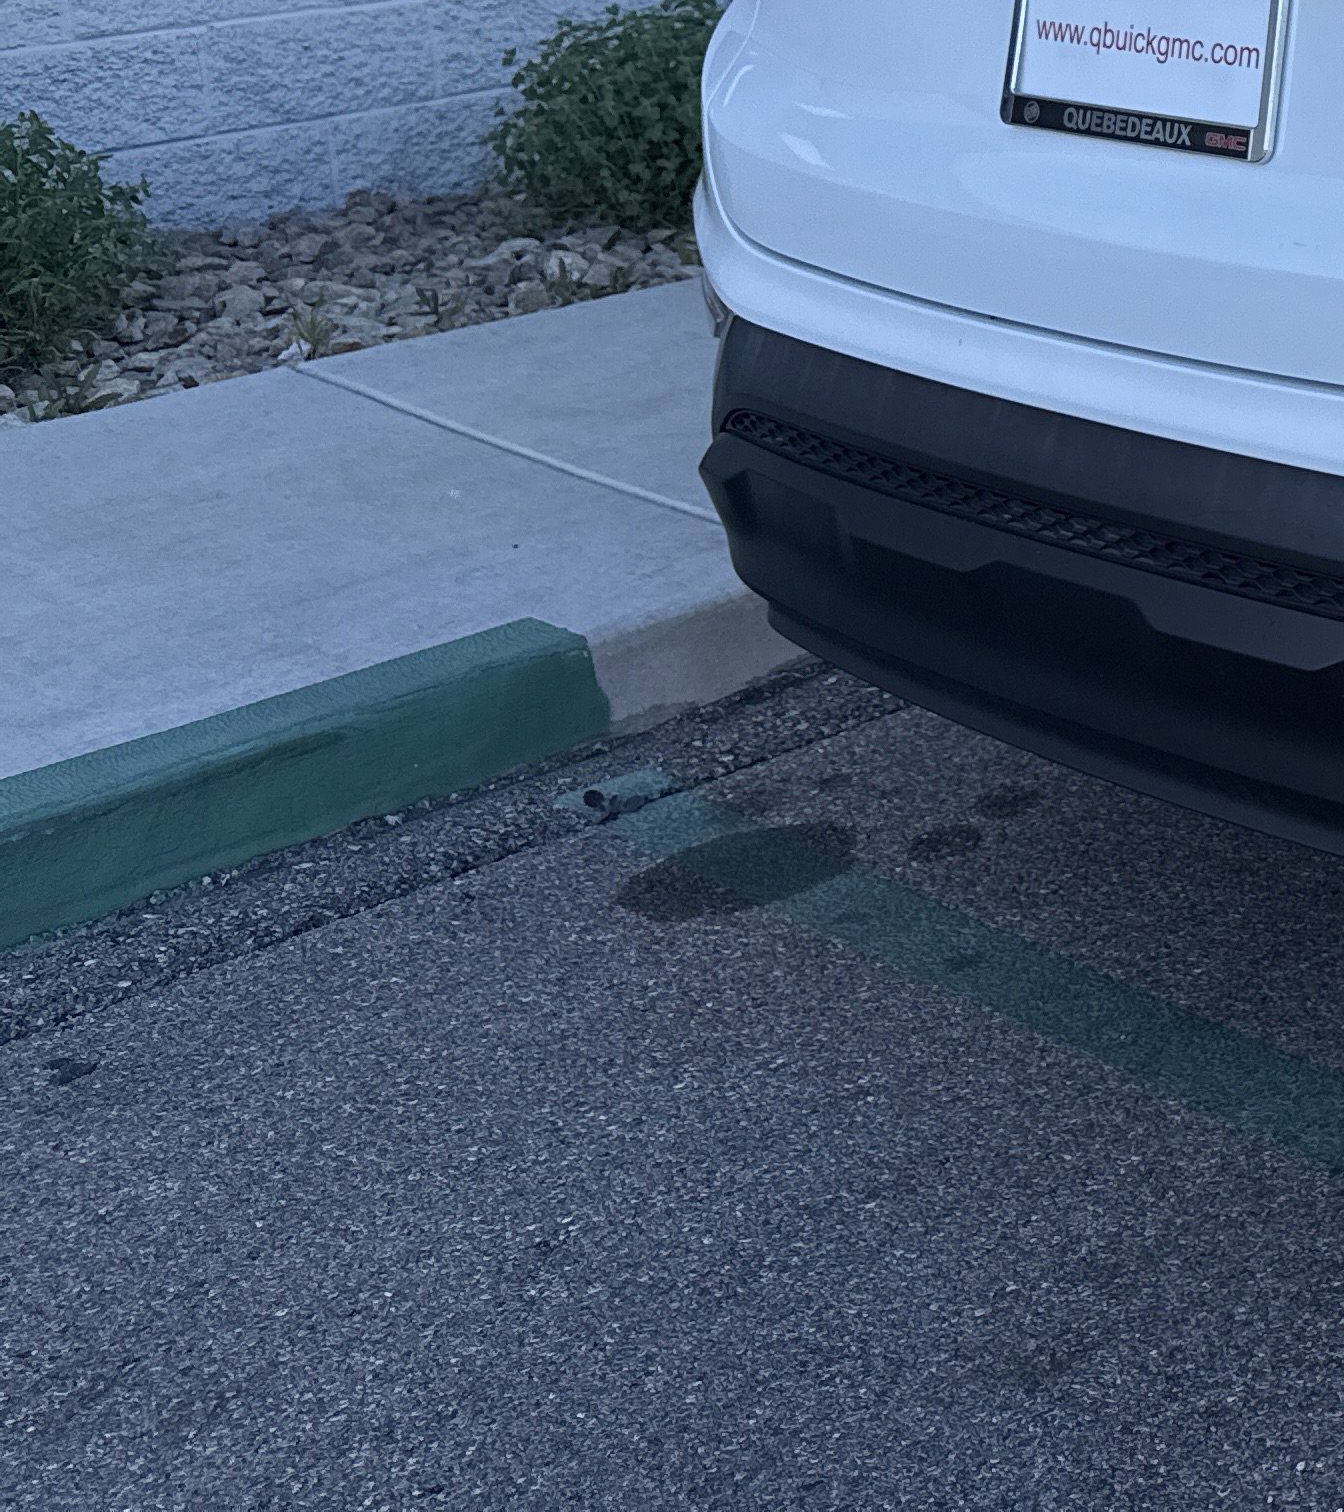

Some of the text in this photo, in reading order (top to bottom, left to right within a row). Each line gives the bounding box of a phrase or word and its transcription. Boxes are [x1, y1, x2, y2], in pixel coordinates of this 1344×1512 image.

[1036, 19, 1261, 69] www.qbuickgmc.com
[1062, 106, 1248, 152] QUEBEDEAUX GMC
